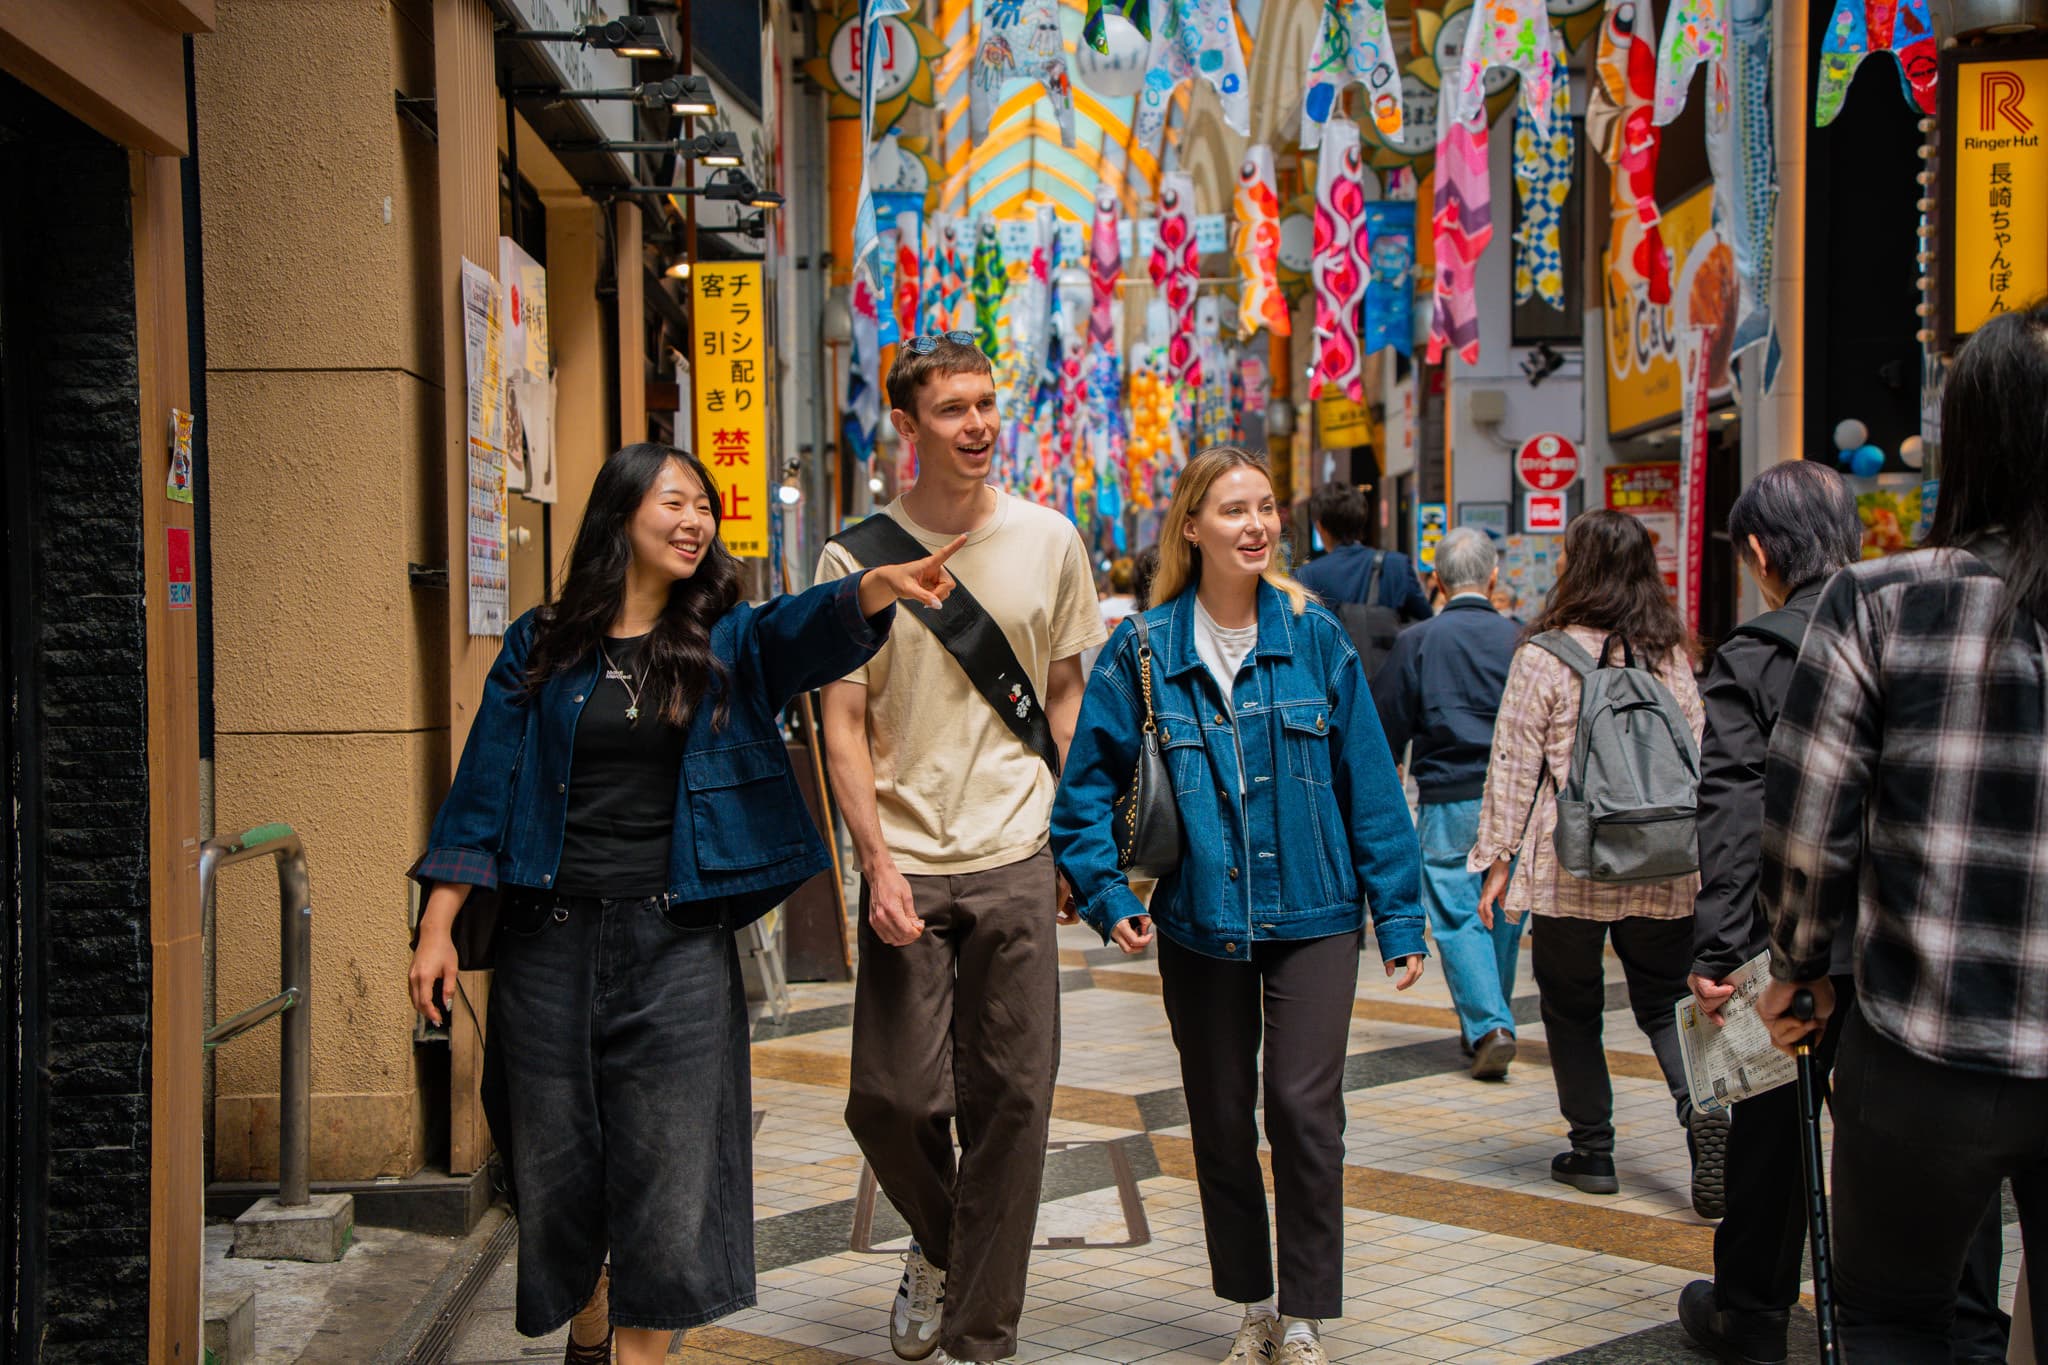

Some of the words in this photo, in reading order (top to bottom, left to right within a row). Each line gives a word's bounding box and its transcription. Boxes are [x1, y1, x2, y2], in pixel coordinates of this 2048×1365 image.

[1964, 137, 2011, 151] Ringer
[2013, 134, 2039, 148] Hut
[1988, 162, 2012, 314] 長崎ちゃんぽん
[700, 272, 727, 413] 客引き
[728, 273, 756, 412] チラシ配り
[712, 427, 753, 521] 禁止
